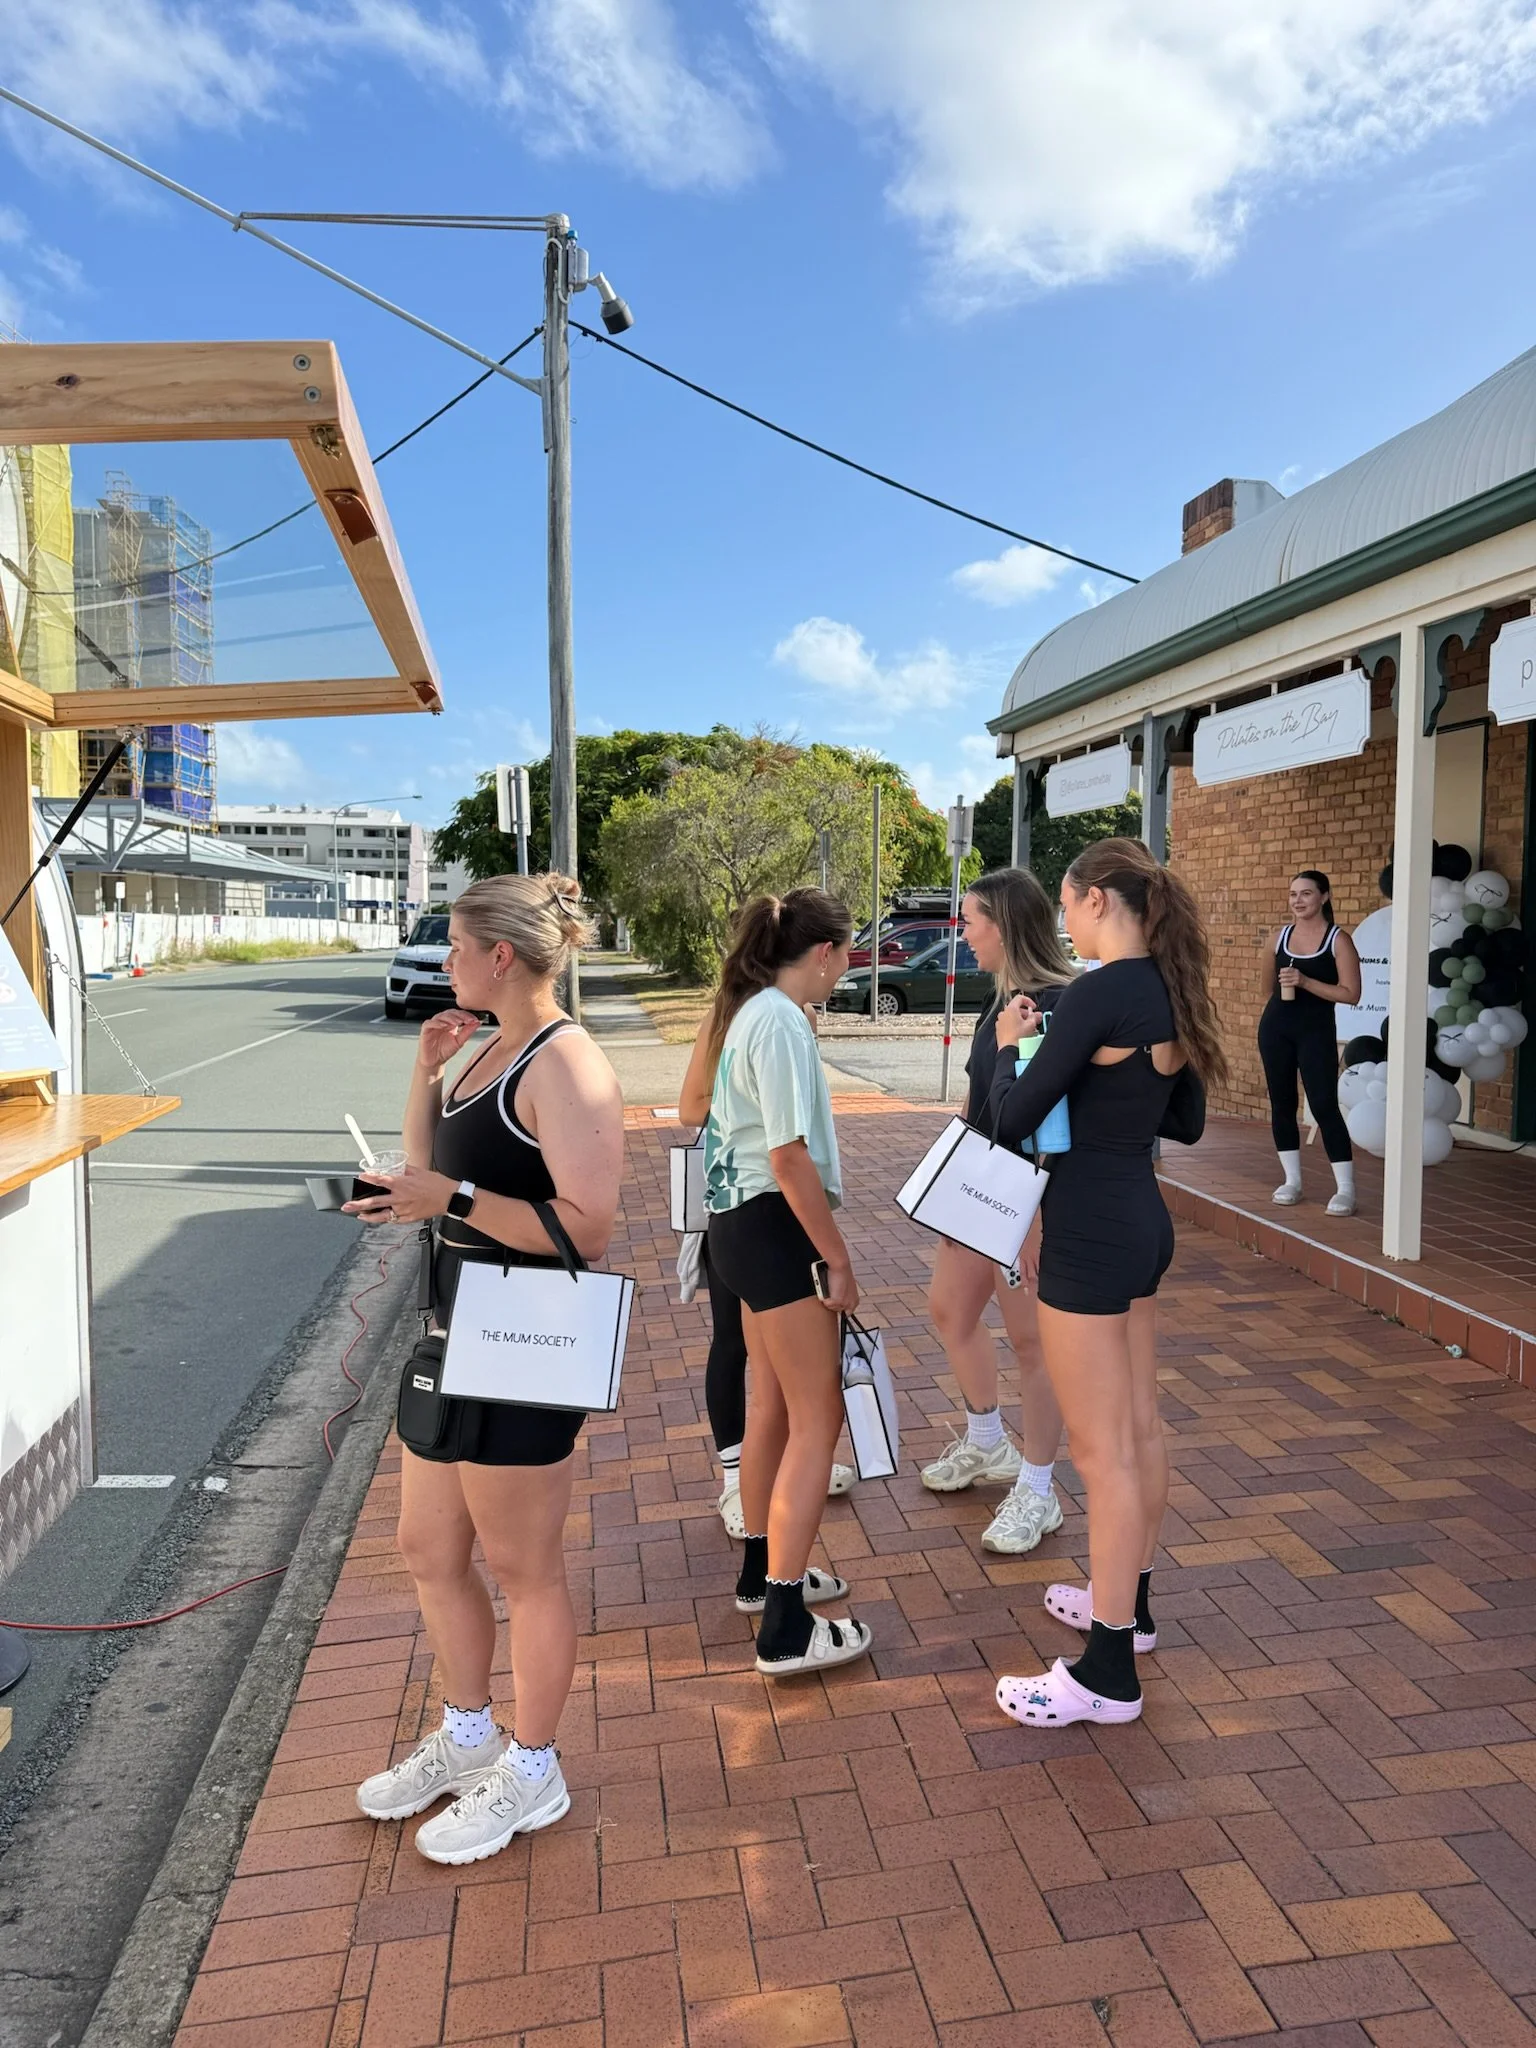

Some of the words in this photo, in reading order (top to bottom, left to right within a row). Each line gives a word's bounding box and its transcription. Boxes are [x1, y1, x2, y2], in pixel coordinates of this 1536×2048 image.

[1217, 723, 1260, 758] Pilates
[1262, 726, 1279, 740] on
[1280, 709, 1302, 737] the
[1291, 702, 1339, 744] Bay
[1366, 1004, 1387, 1012] Mum
[960, 1183, 975, 1196] THE
[973, 1190, 993, 1205] MUM
[991, 1200, 1020, 1220] SOCIETY
[481, 1329, 502, 1342] THE
[503, 1331, 532, 1344] MUM
[532, 1334, 577, 1348] SOCIETY
